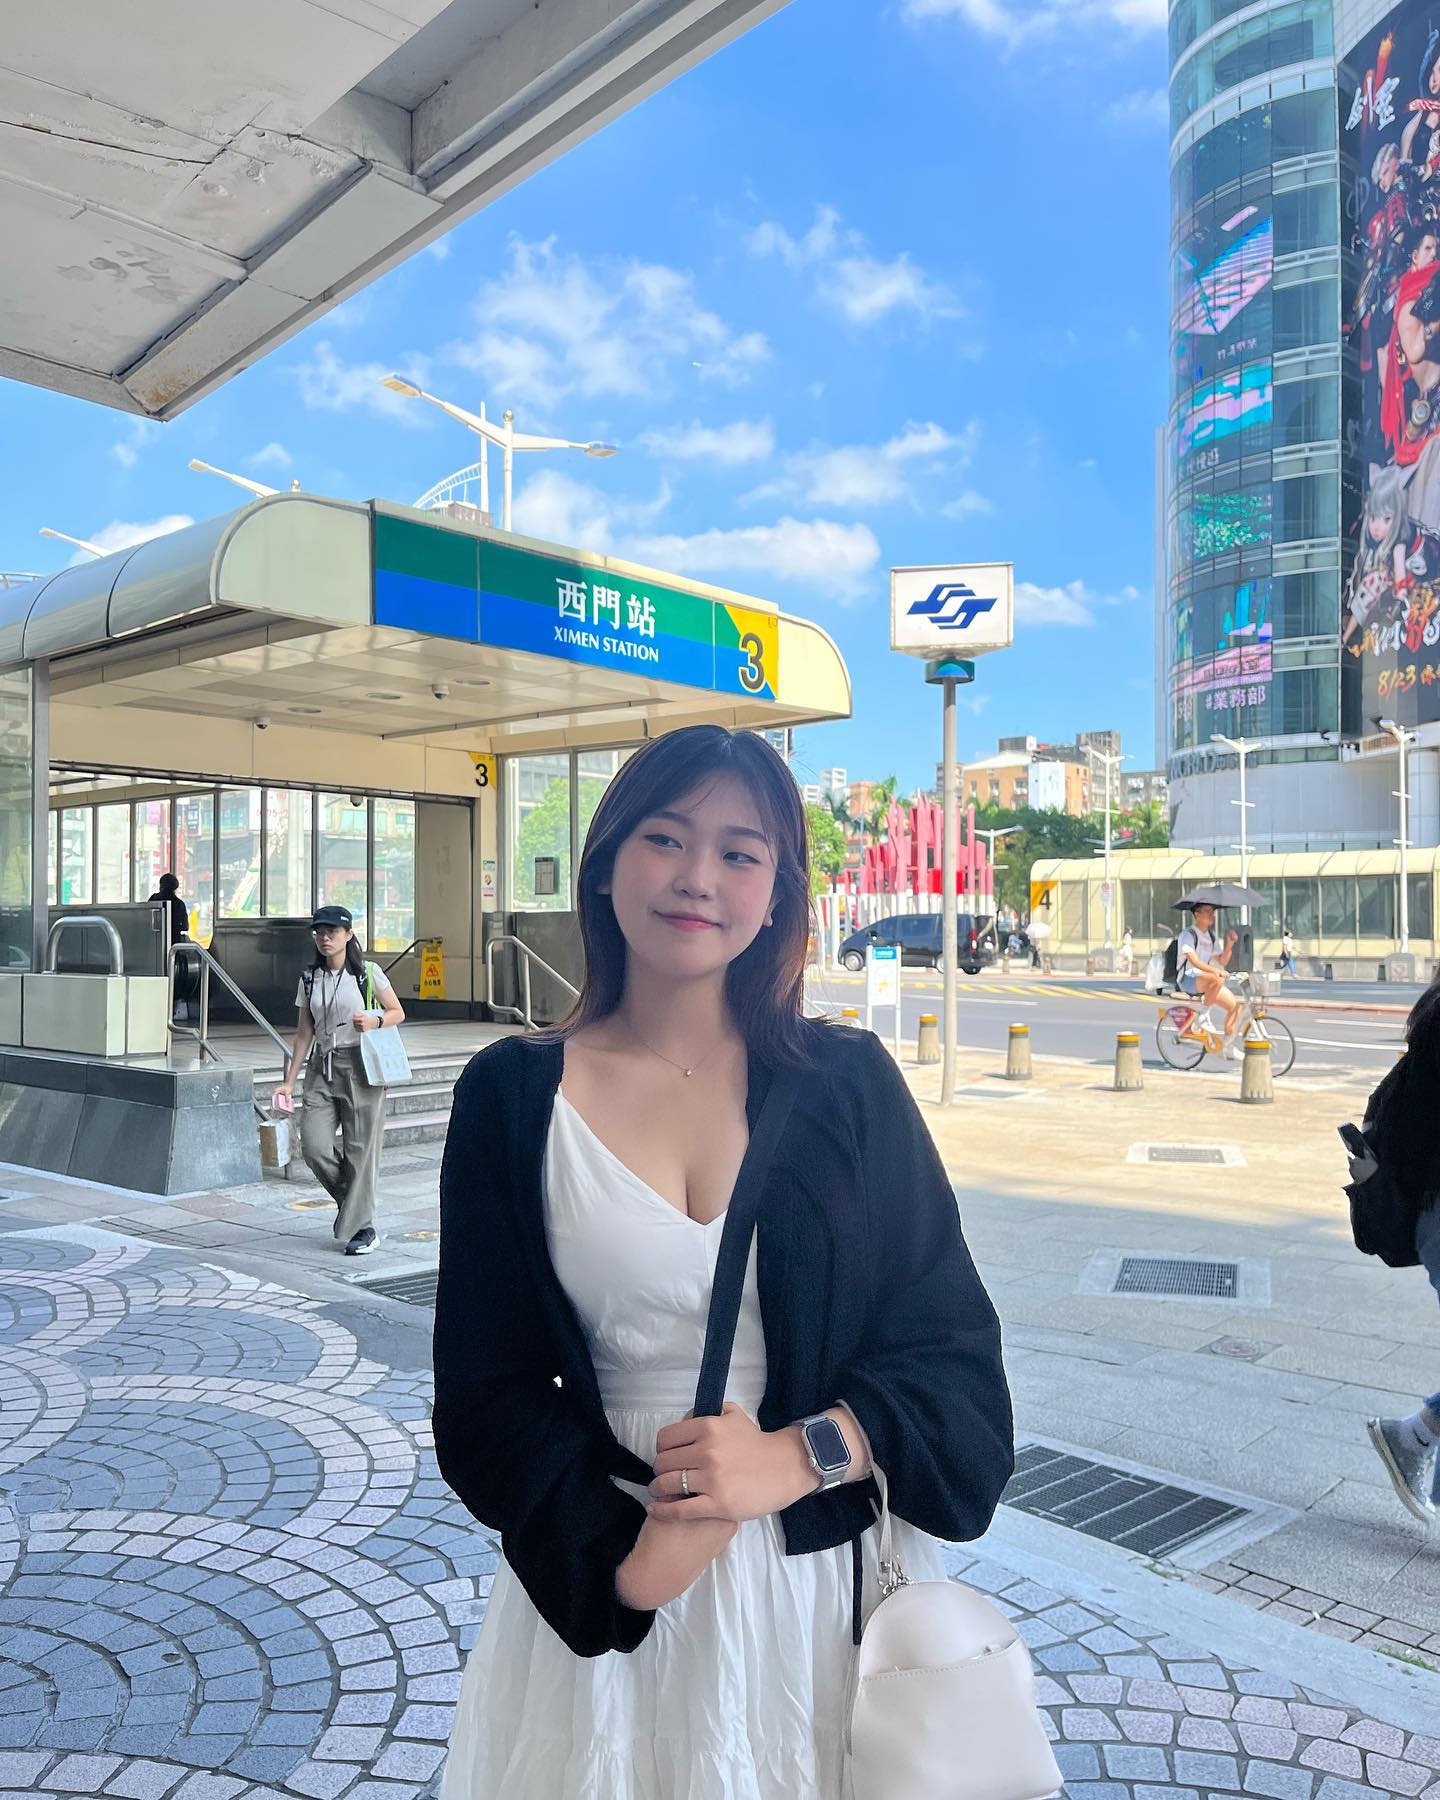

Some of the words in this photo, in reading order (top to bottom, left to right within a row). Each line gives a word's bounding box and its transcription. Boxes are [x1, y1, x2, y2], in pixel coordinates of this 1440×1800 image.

[556, 577, 656, 639] 西門站
[554, 625, 599, 650] XIMEN
[603, 636, 659, 663] STATION
[739, 632, 765, 693] 3
[1377, 664, 1416, 697] 8/23
[475, 763, 488, 787] 3
[1039, 889, 1053, 910] 4
